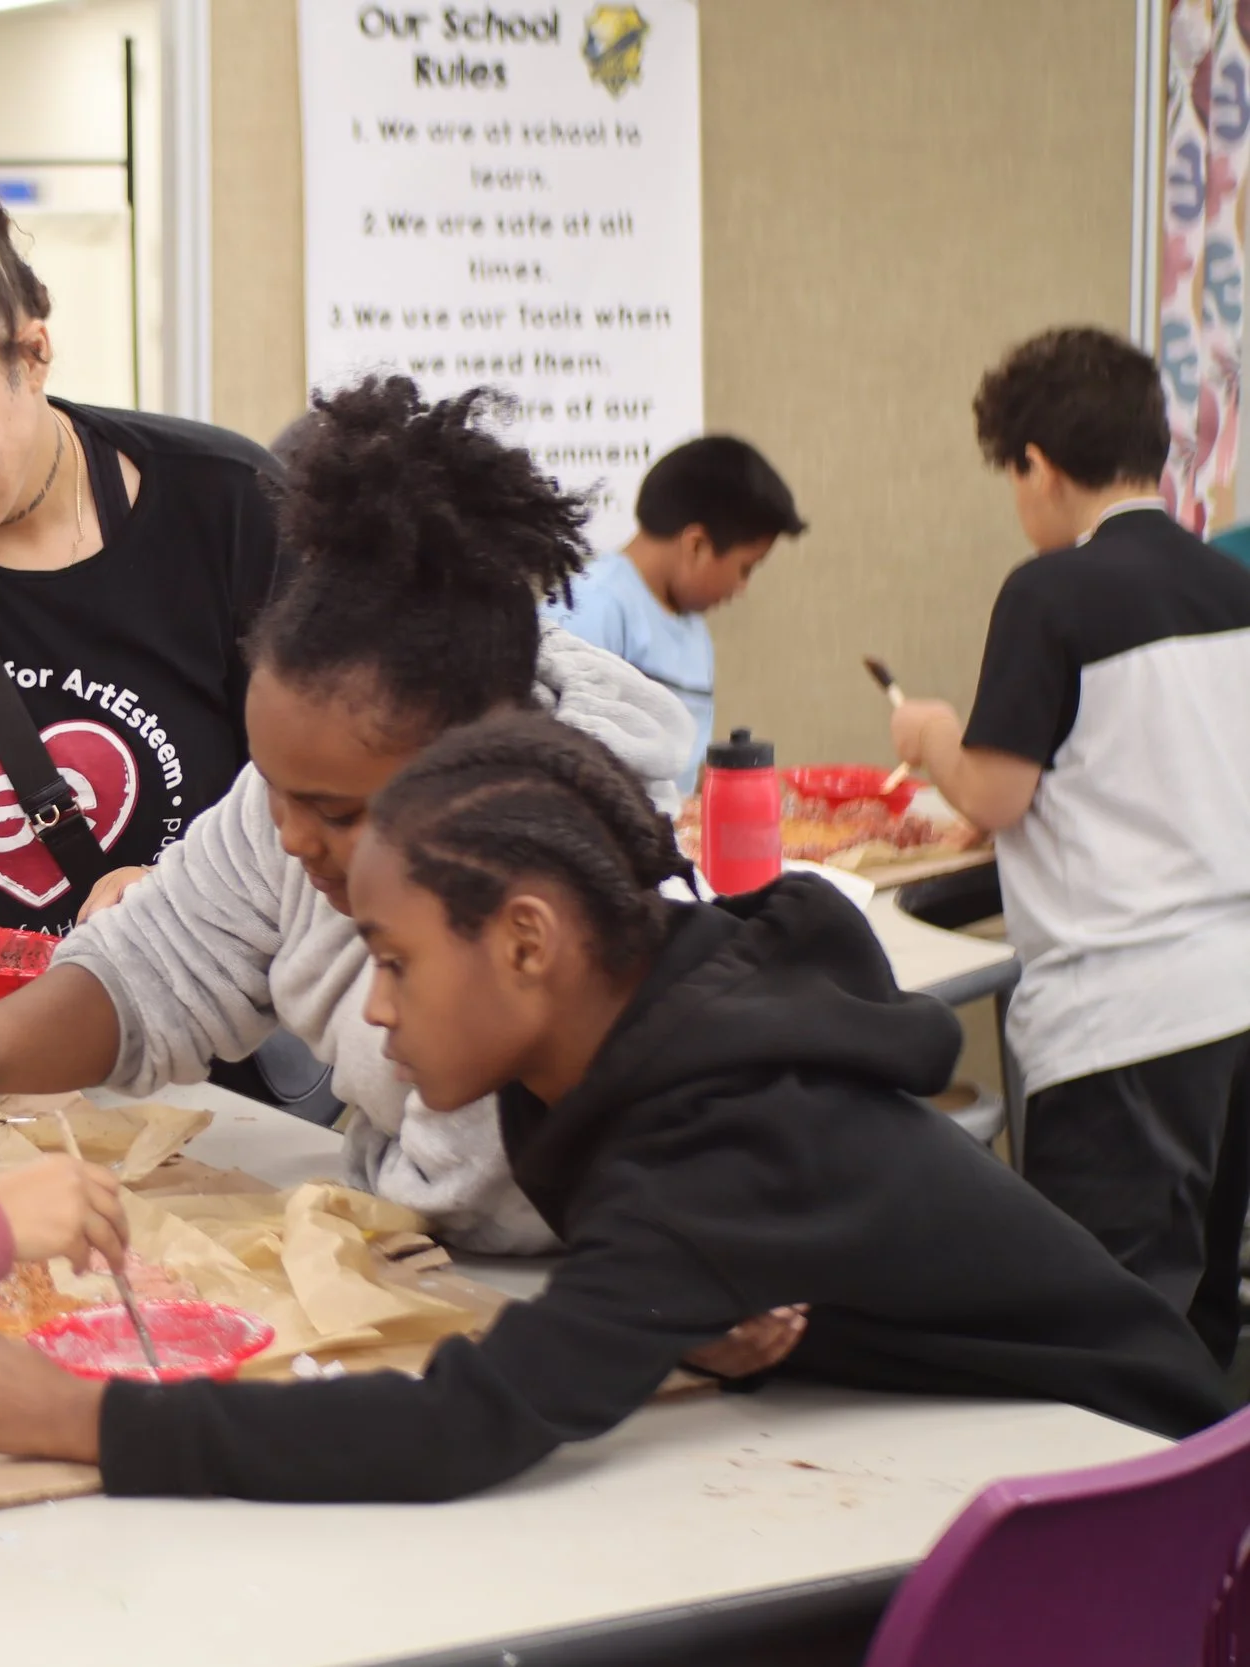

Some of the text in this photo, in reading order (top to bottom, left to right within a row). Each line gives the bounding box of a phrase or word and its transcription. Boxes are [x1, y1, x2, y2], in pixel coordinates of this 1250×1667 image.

[358, 4, 560, 44] Our School
[413, 53, 508, 90] Rules
[378, 118, 417, 142] We
[427, 121, 475, 144] are
[484, 118, 511, 145] at
[521, 118, 606, 146] school
[615, 119, 641, 146] to
[437, 213, 485, 236] are
[496, 209, 552, 236] safe
[562, 209, 591, 236] at
[600, 210, 633, 236] all
[402, 307, 449, 329] use
[460, 307, 506, 329] our
[594, 302, 670, 329] when
[408, 355, 445, 377] we
[455, 350, 524, 376] need
[565, 394, 594, 422] of
[604, 398, 652, 421] our
[4, 661, 54, 688] for
[61, 668, 184, 790] ArtEsteem
